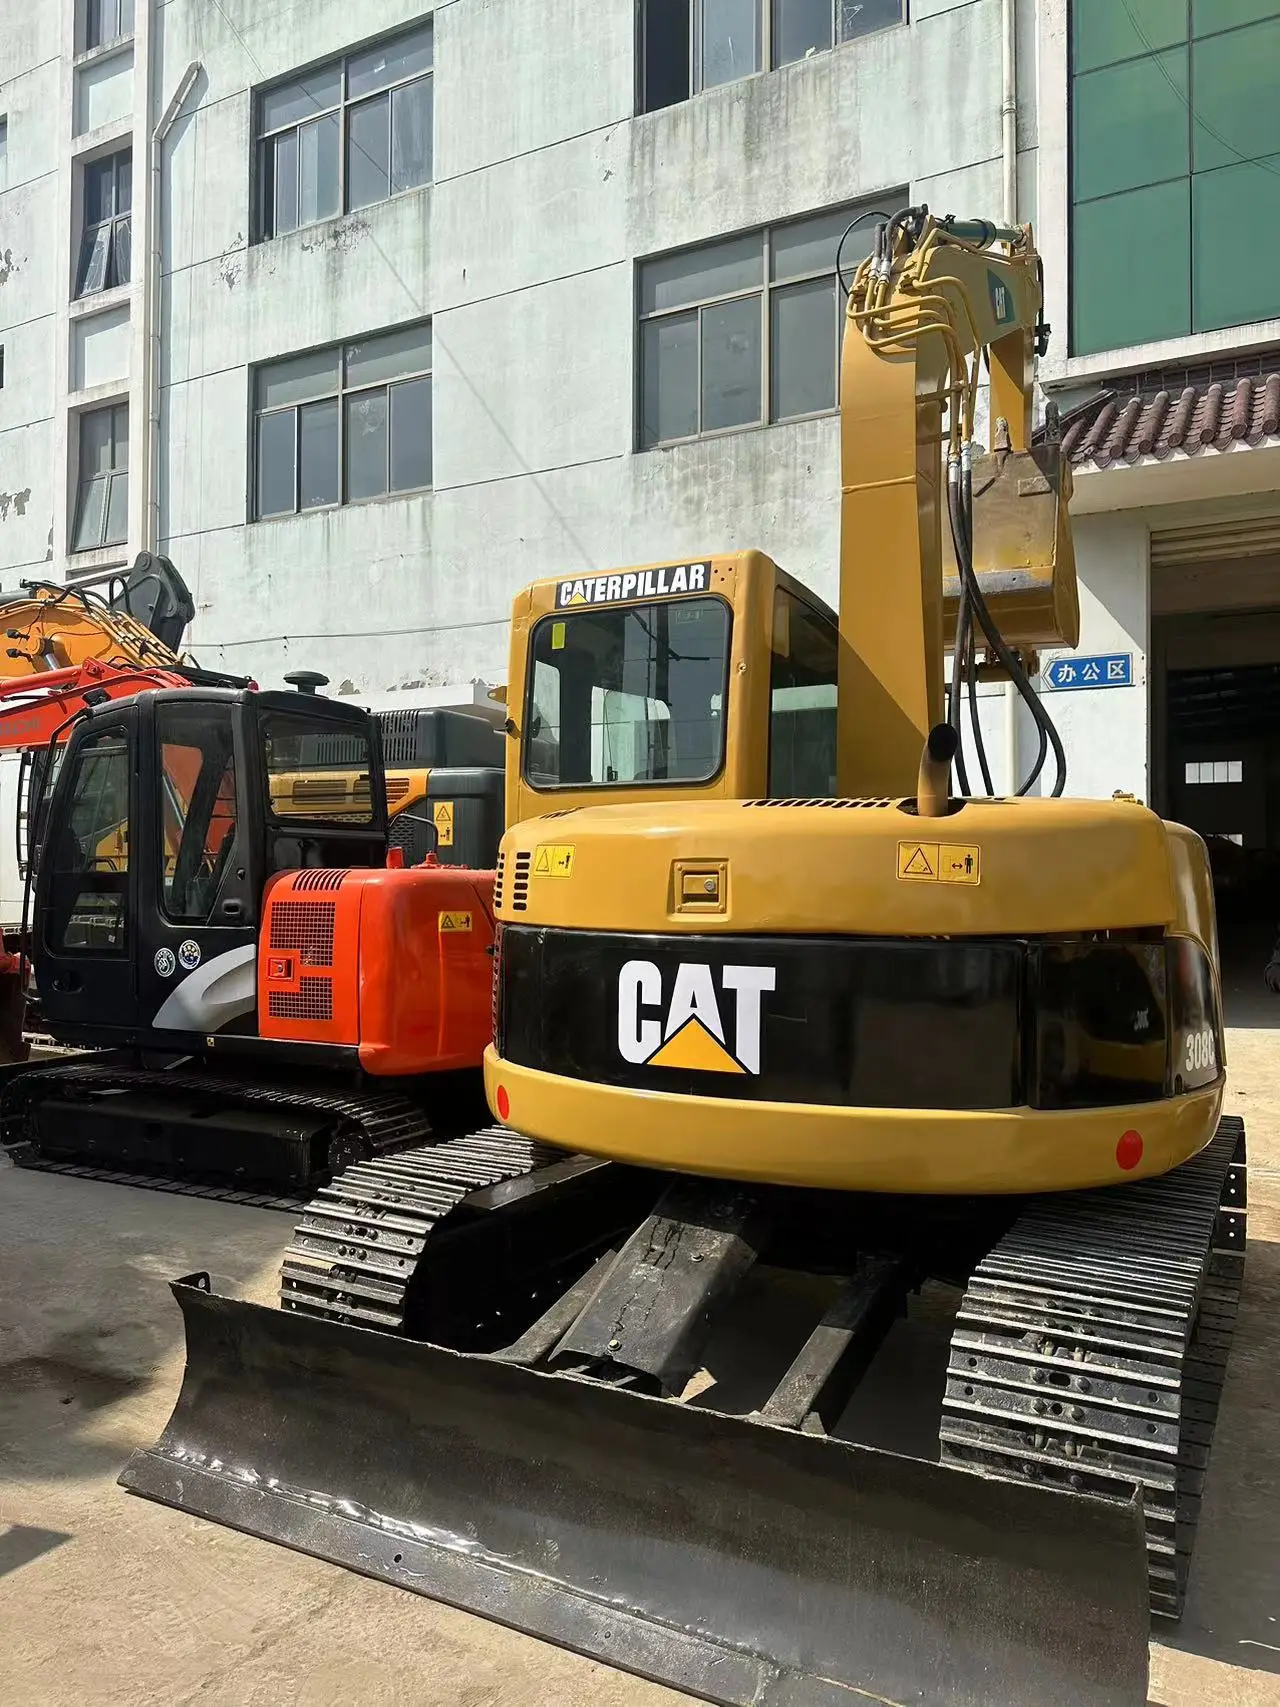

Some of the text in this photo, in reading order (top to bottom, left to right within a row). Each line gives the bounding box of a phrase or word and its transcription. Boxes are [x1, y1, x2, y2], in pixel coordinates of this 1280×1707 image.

[560, 564, 705, 606] CATERPILLAR
[1057, 660, 1126, 683] 办公区
[618, 960, 776, 1075] CAT
